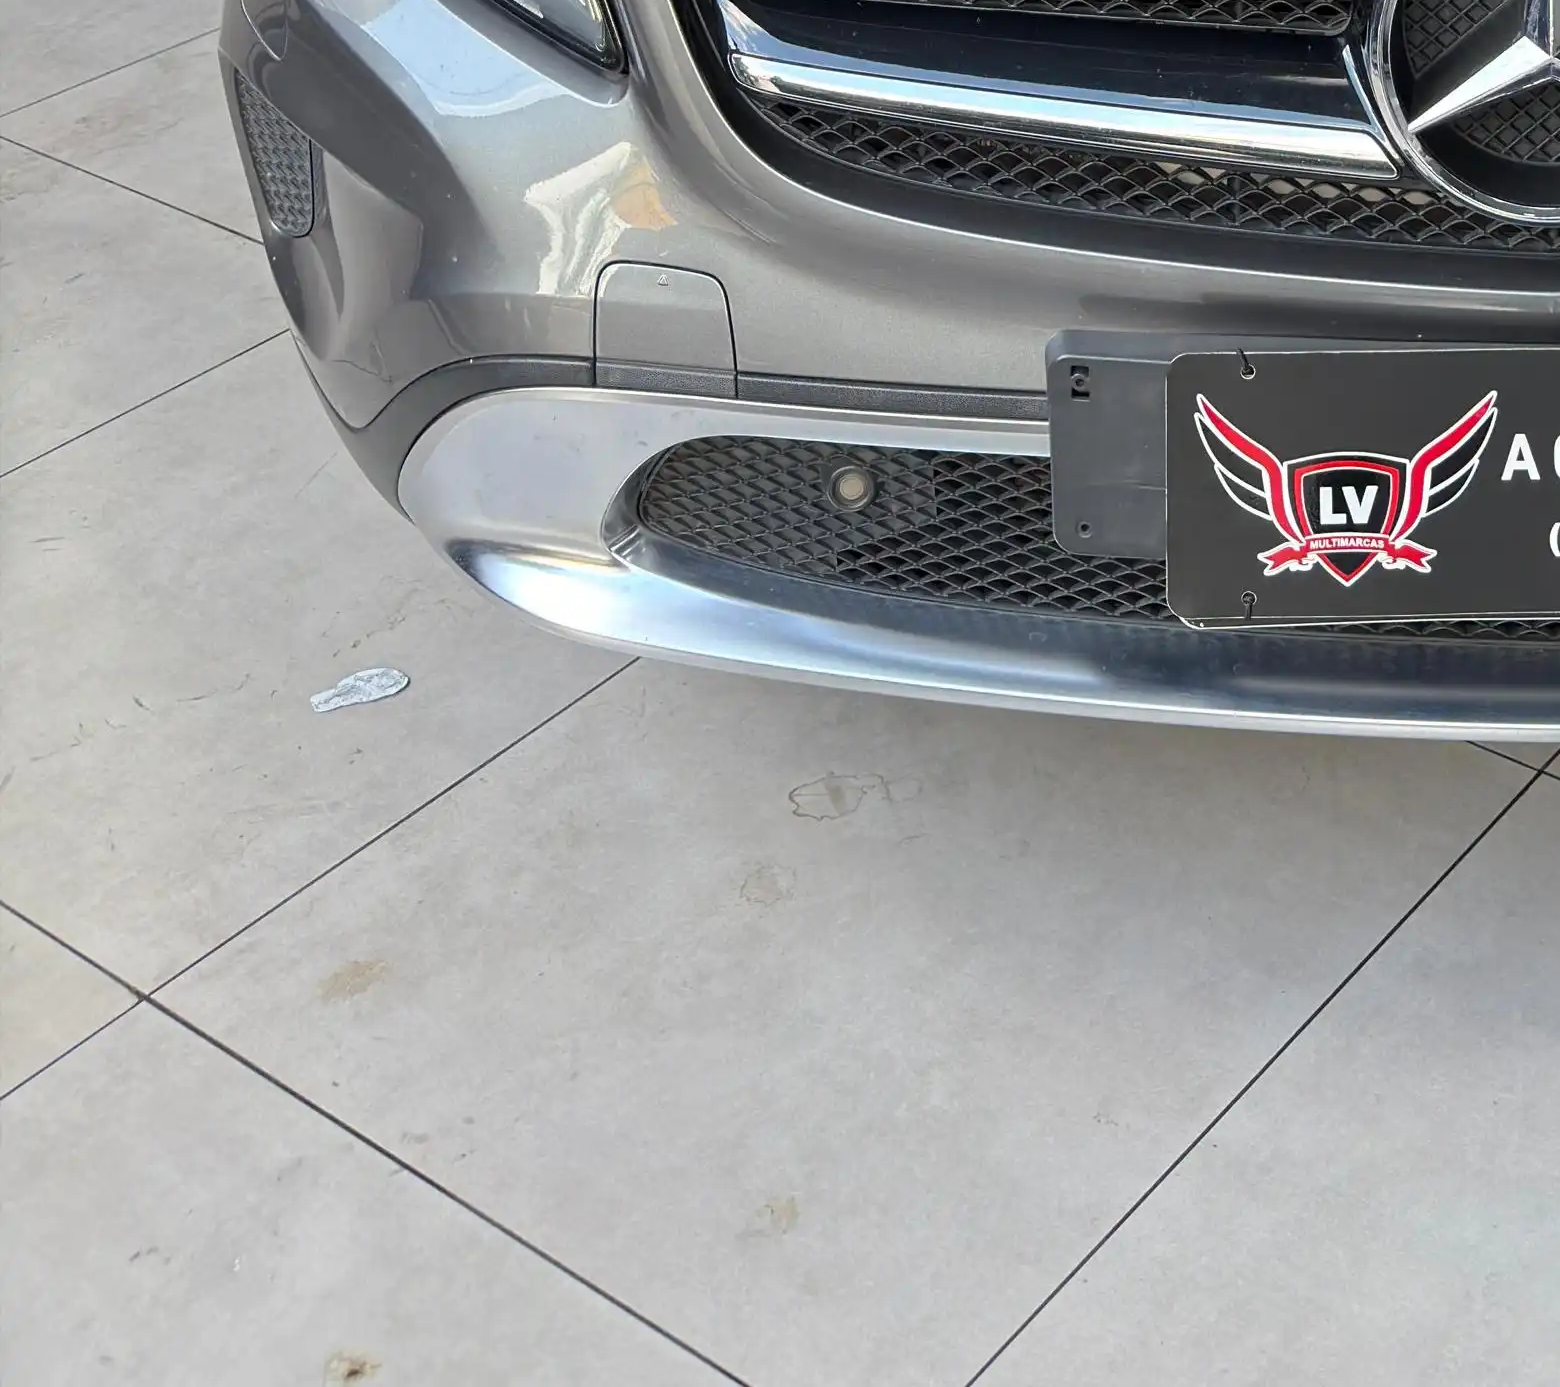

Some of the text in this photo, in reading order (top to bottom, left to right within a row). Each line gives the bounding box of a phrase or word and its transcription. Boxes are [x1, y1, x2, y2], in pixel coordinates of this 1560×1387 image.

[1501, 433, 1541, 481] A
[1319, 485, 1379, 525] LV
[1309, 538, 1385, 550] MULTIMARCAS
